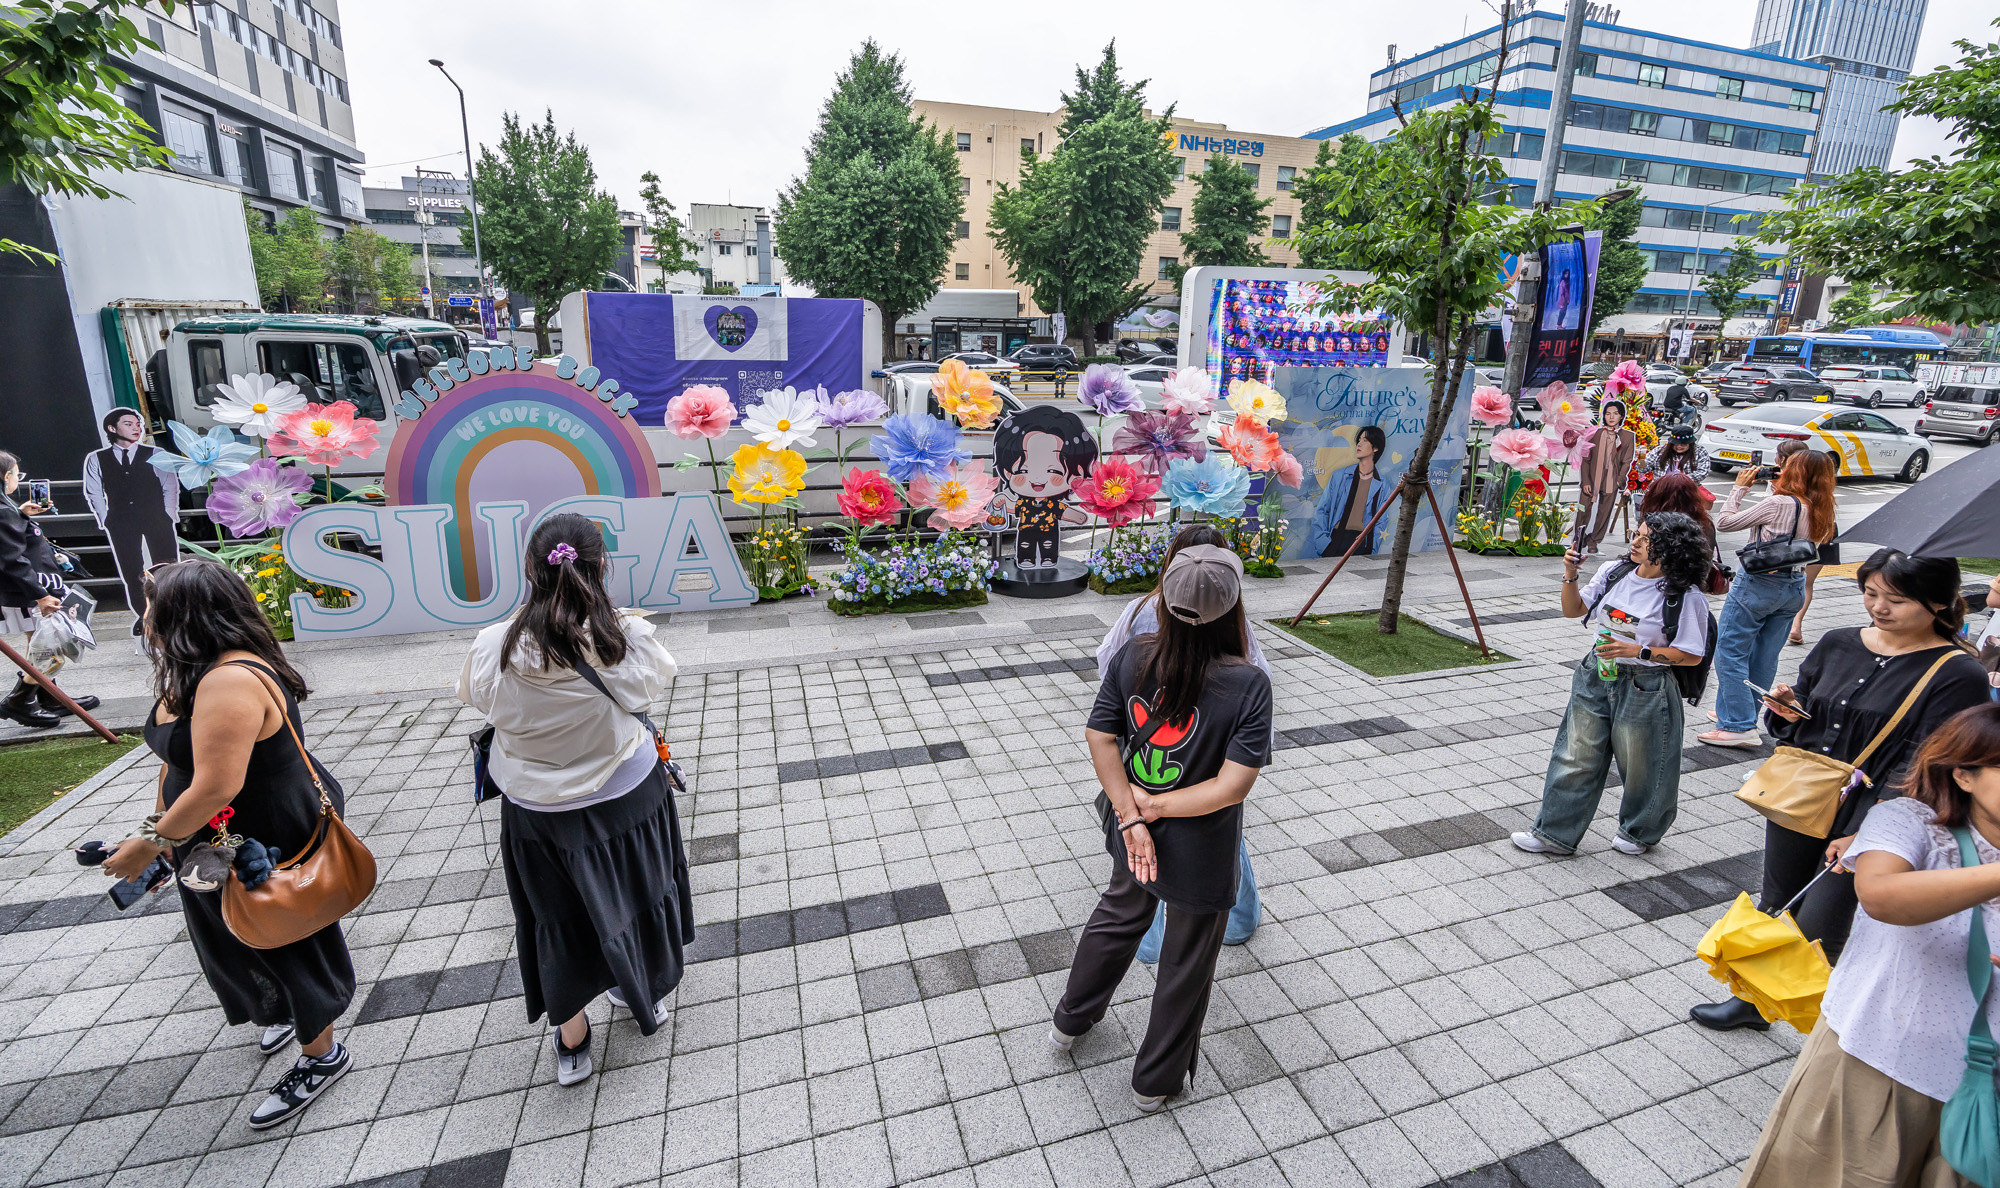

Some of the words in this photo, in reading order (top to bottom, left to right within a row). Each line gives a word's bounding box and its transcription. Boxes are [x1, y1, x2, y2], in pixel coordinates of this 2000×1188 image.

[1180, 134, 1264, 157] NH농협은행
[394, 346, 534, 421] WELCOME
[555, 354, 638, 418] BACK
[456, 416, 486, 441] WE
[488, 406, 540, 426] LOVE
[548, 411, 586, 440] YOU
